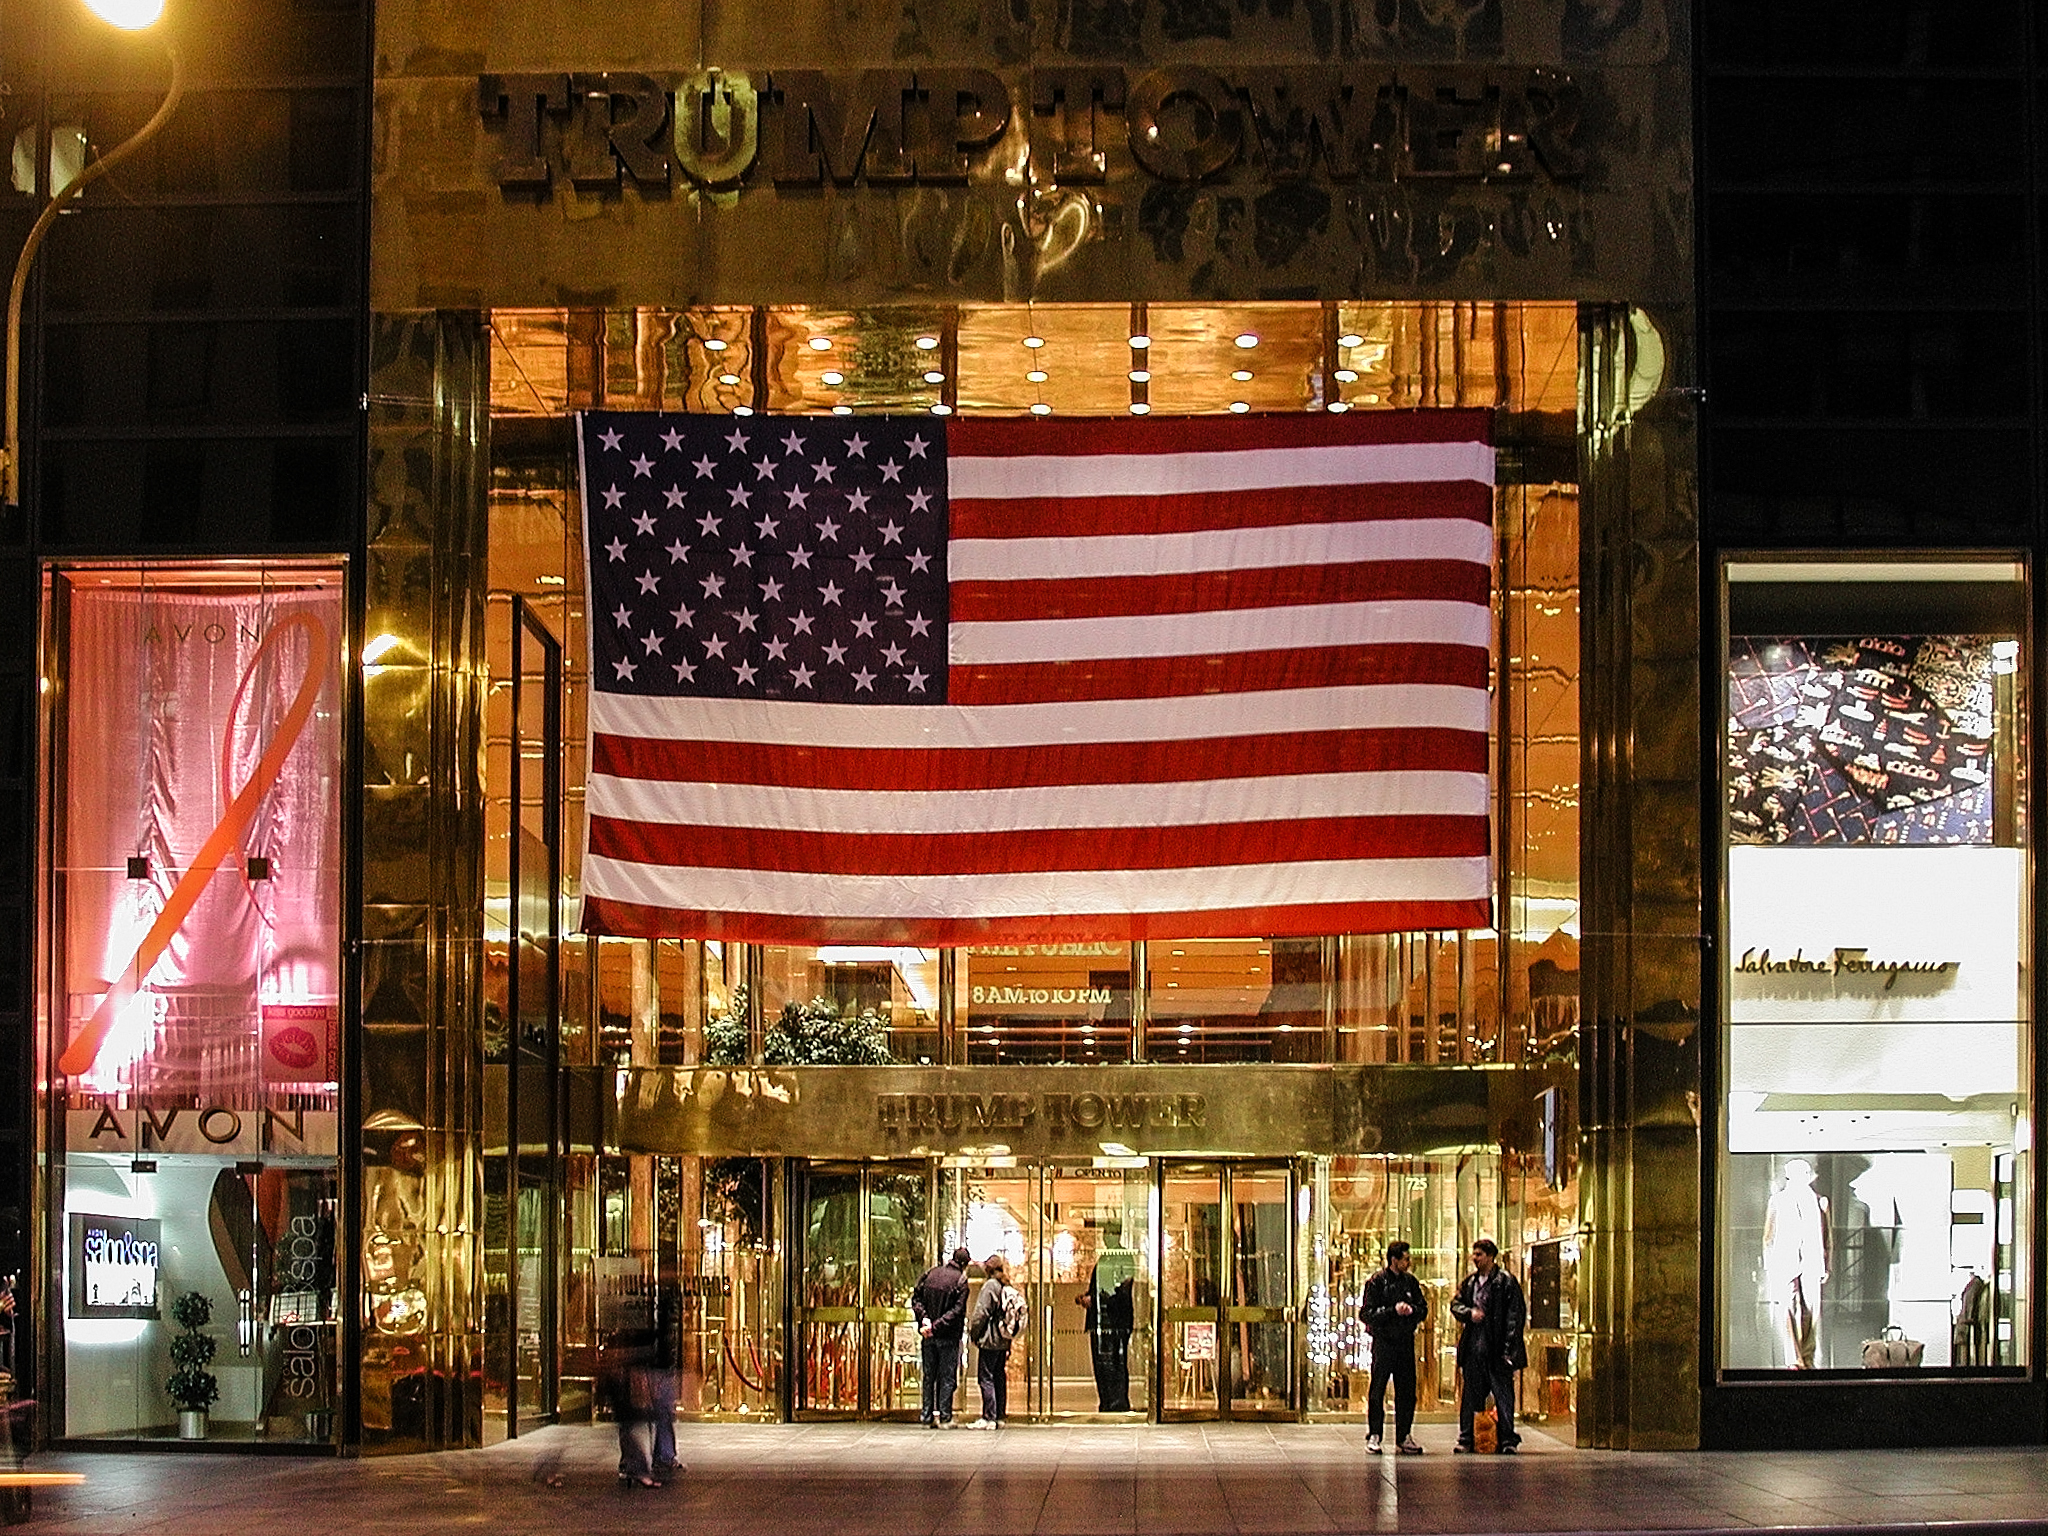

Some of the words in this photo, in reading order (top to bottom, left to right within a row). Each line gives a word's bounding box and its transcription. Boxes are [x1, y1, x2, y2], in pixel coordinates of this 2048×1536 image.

[479, 67, 1010, 187] TRUMP
[1032, 64, 1586, 182] TOWER
[143, 624, 260, 643] AVON
[1735, 947, 1831, 975] Salvatore
[1833, 947, 1961, 990] Ferragamo
[89, 1104, 303, 1144] AVON
[878, 1092, 1037, 1128] TRUMP
[1043, 1092, 1206, 1128] TOWER
[1405, 1176, 1428, 1191] 725
